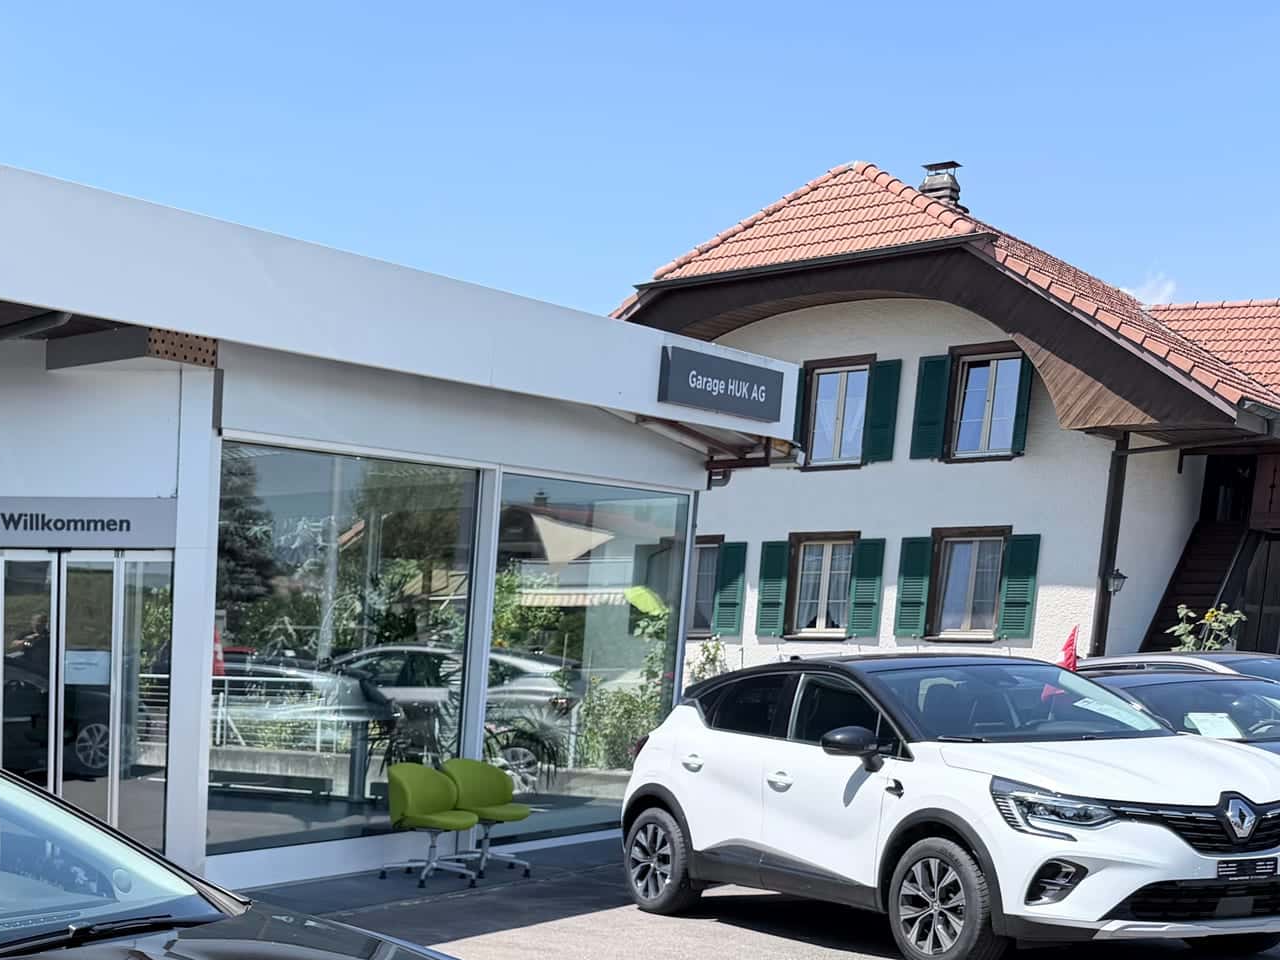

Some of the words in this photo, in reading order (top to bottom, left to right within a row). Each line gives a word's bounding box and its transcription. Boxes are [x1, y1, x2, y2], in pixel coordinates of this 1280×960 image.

[688, 370, 725, 396] Garage
[727, 378, 750, 399] HUK
[750, 385, 766, 402] AG
[0, 512, 131, 532] Willkommen
